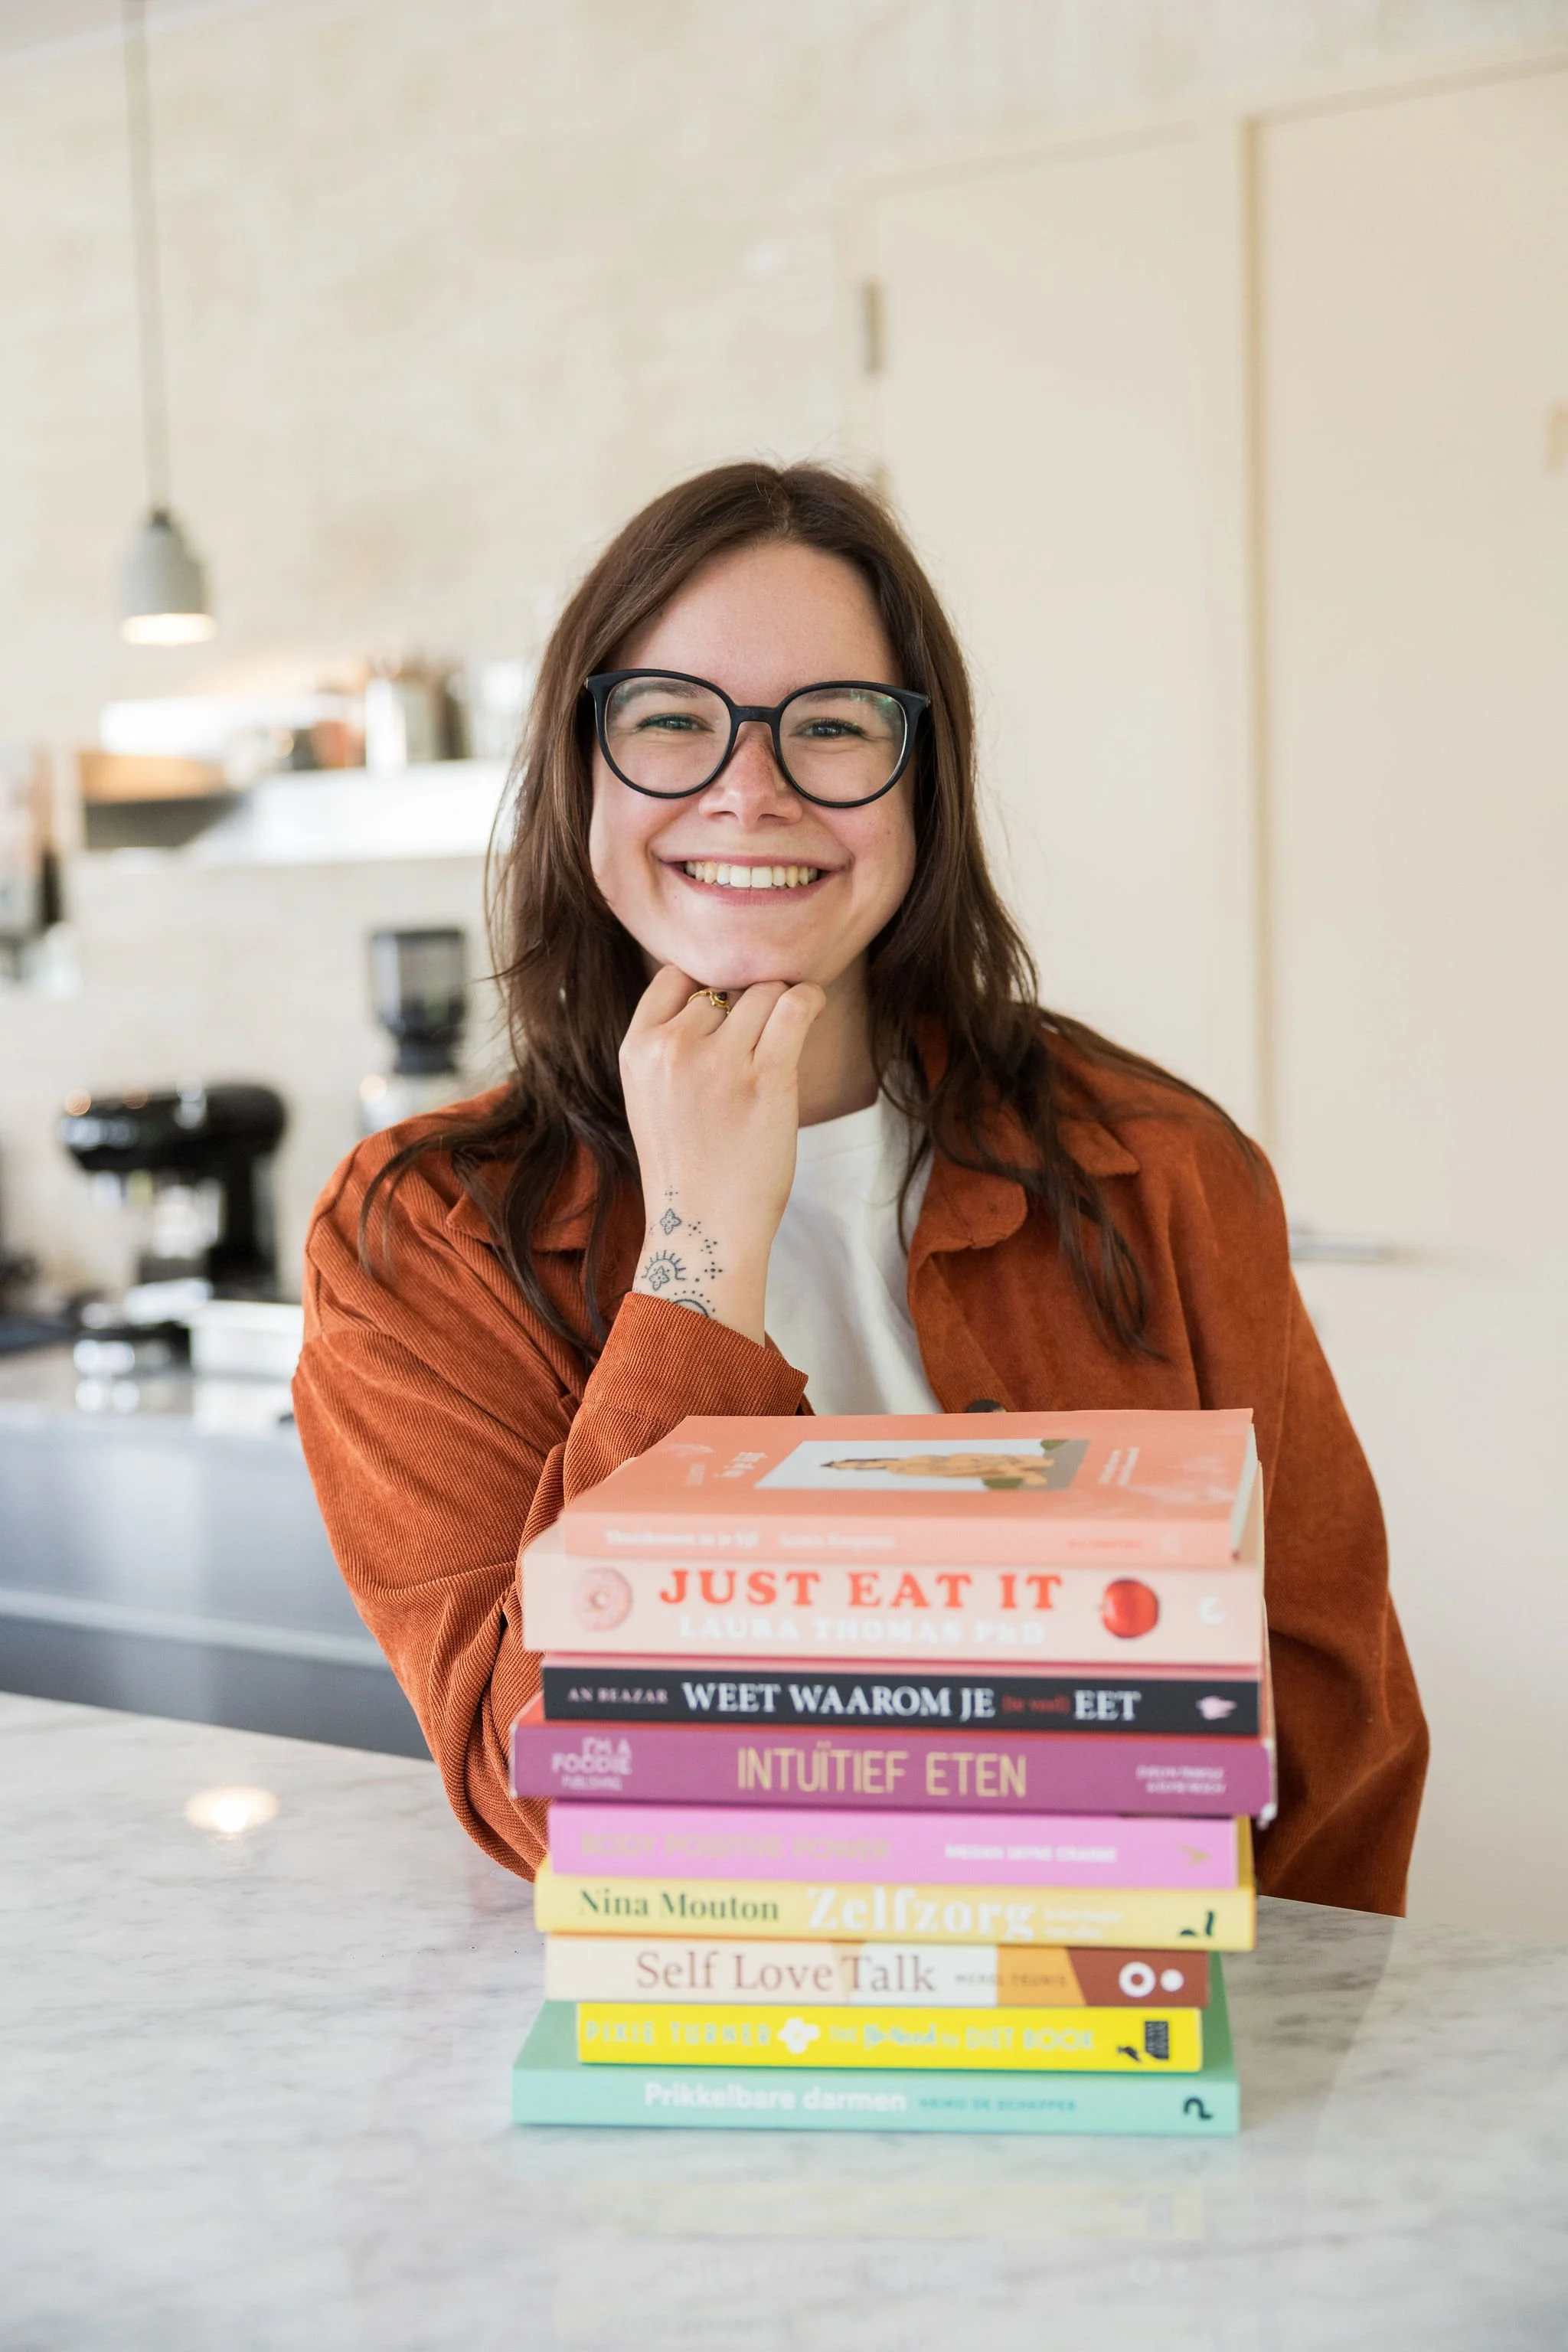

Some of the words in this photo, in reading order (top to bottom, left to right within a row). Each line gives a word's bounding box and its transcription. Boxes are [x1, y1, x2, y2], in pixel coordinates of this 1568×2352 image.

[659, 1569, 822, 1607] JUST
[847, 1572, 973, 1609] EAT
[998, 1573, 1063, 1611] IT
[678, 1615, 799, 1640] LAURA
[813, 1618, 962, 1644] THOMAS
[974, 1620, 1046, 1646] PhD
[567, 1687, 593, 1703] AN
[681, 1682, 781, 1713] WEET
[788, 1684, 952, 1717] WAAROM
[959, 1687, 996, 1722] JE
[1073, 1689, 1142, 1722] EET
[550, 1752, 633, 1776] FOODIE
[737, 1740, 910, 1794] INTUÏTIEF
[925, 1751, 1027, 1798] ETEN
[580, 1832, 661, 1857] BODY
[665, 1833, 783, 1859] POSITIVE
[792, 1837, 891, 1861] POWER
[580, 1887, 649, 1916] Nina
[660, 1892, 781, 1922] Mouton
[806, 1885, 1036, 1942] Zelfzorg
[636, 1950, 719, 1990] Self
[732, 1953, 834, 1991] Love
[841, 1953, 938, 1993] Talk
[585, 2020, 656, 2046] PIXIE
[668, 2021, 773, 2047] TURNER
[965, 2027, 1014, 2051] DIET
[1022, 2027, 1096, 2052] BOOK
[645, 2081, 797, 2111] Prikkelbare
[802, 2086, 908, 2112] darmen
